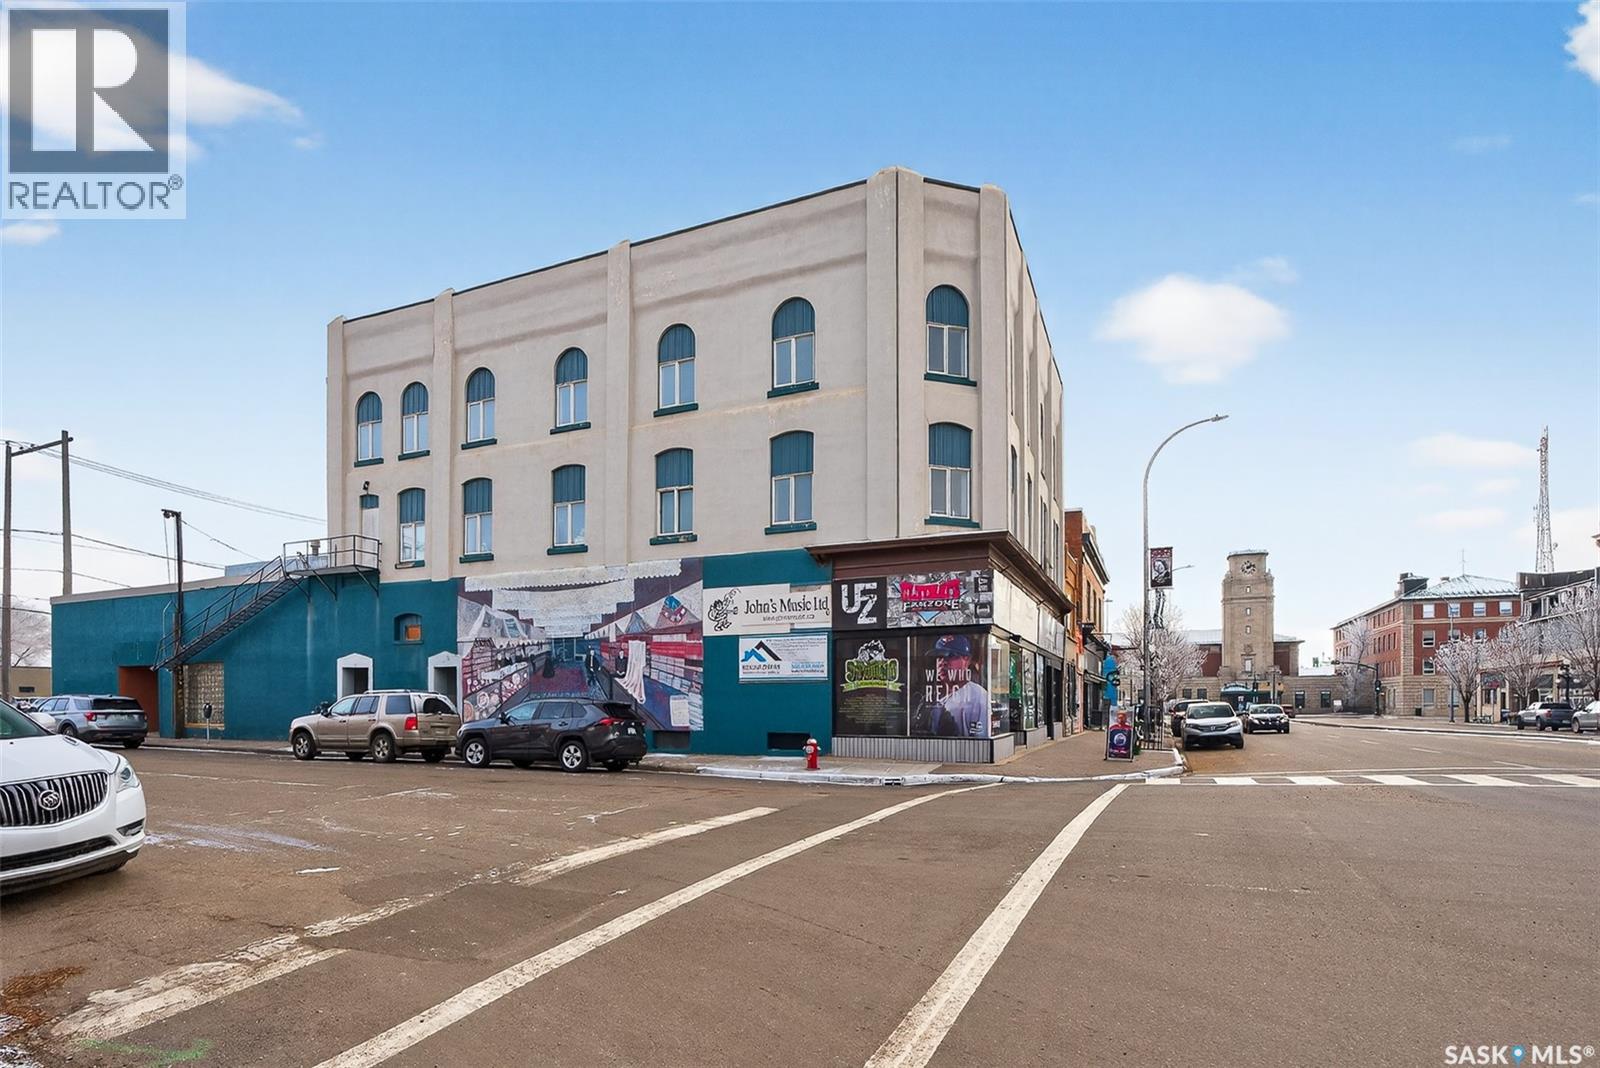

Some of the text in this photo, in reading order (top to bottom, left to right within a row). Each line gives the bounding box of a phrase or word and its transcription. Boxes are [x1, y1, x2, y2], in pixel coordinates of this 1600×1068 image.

[744, 599, 777, 614] John's
[779, 594, 812, 612] Music
[925, 669, 972, 681] WE WHO
